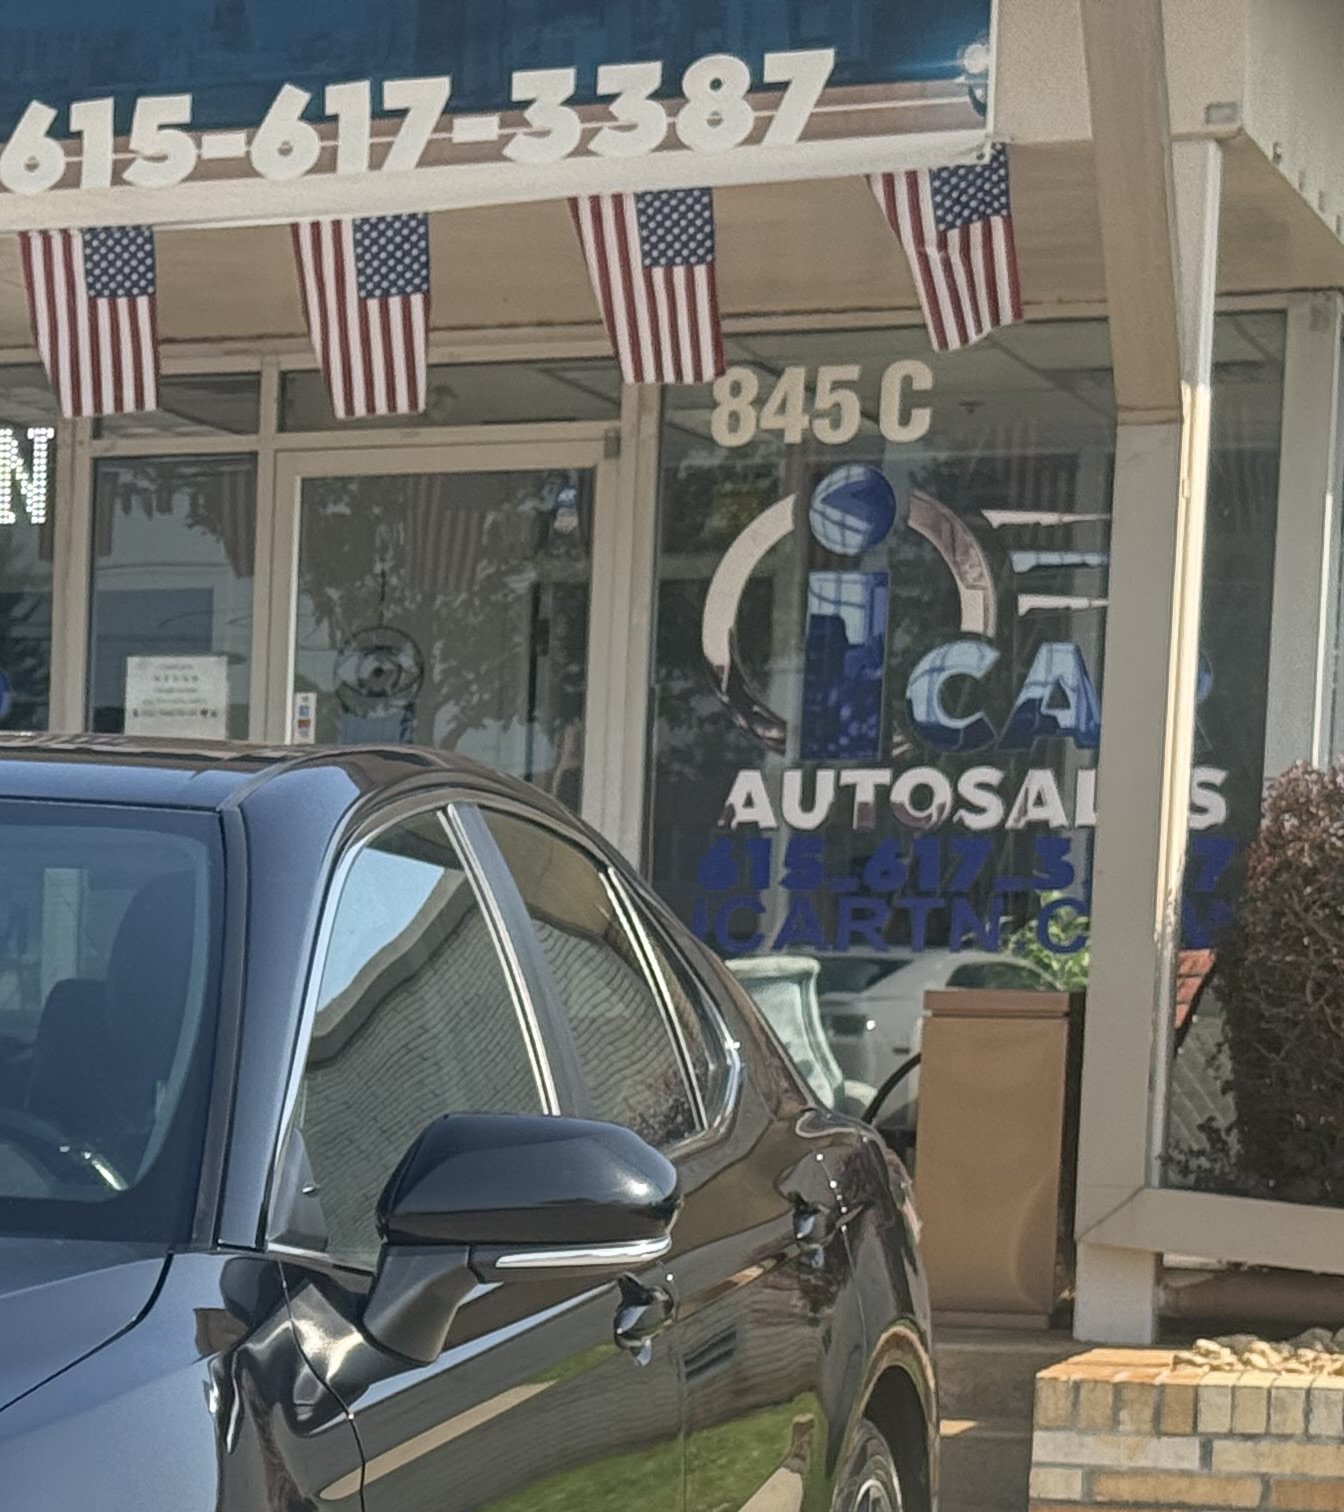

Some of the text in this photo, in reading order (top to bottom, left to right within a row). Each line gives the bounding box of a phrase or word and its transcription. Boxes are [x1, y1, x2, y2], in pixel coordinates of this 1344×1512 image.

[711, 358, 934, 448] 845 C
[718, 765, 1228, 831] AUTOSAS
[691, 897, 1235, 955] ICARTN.C
